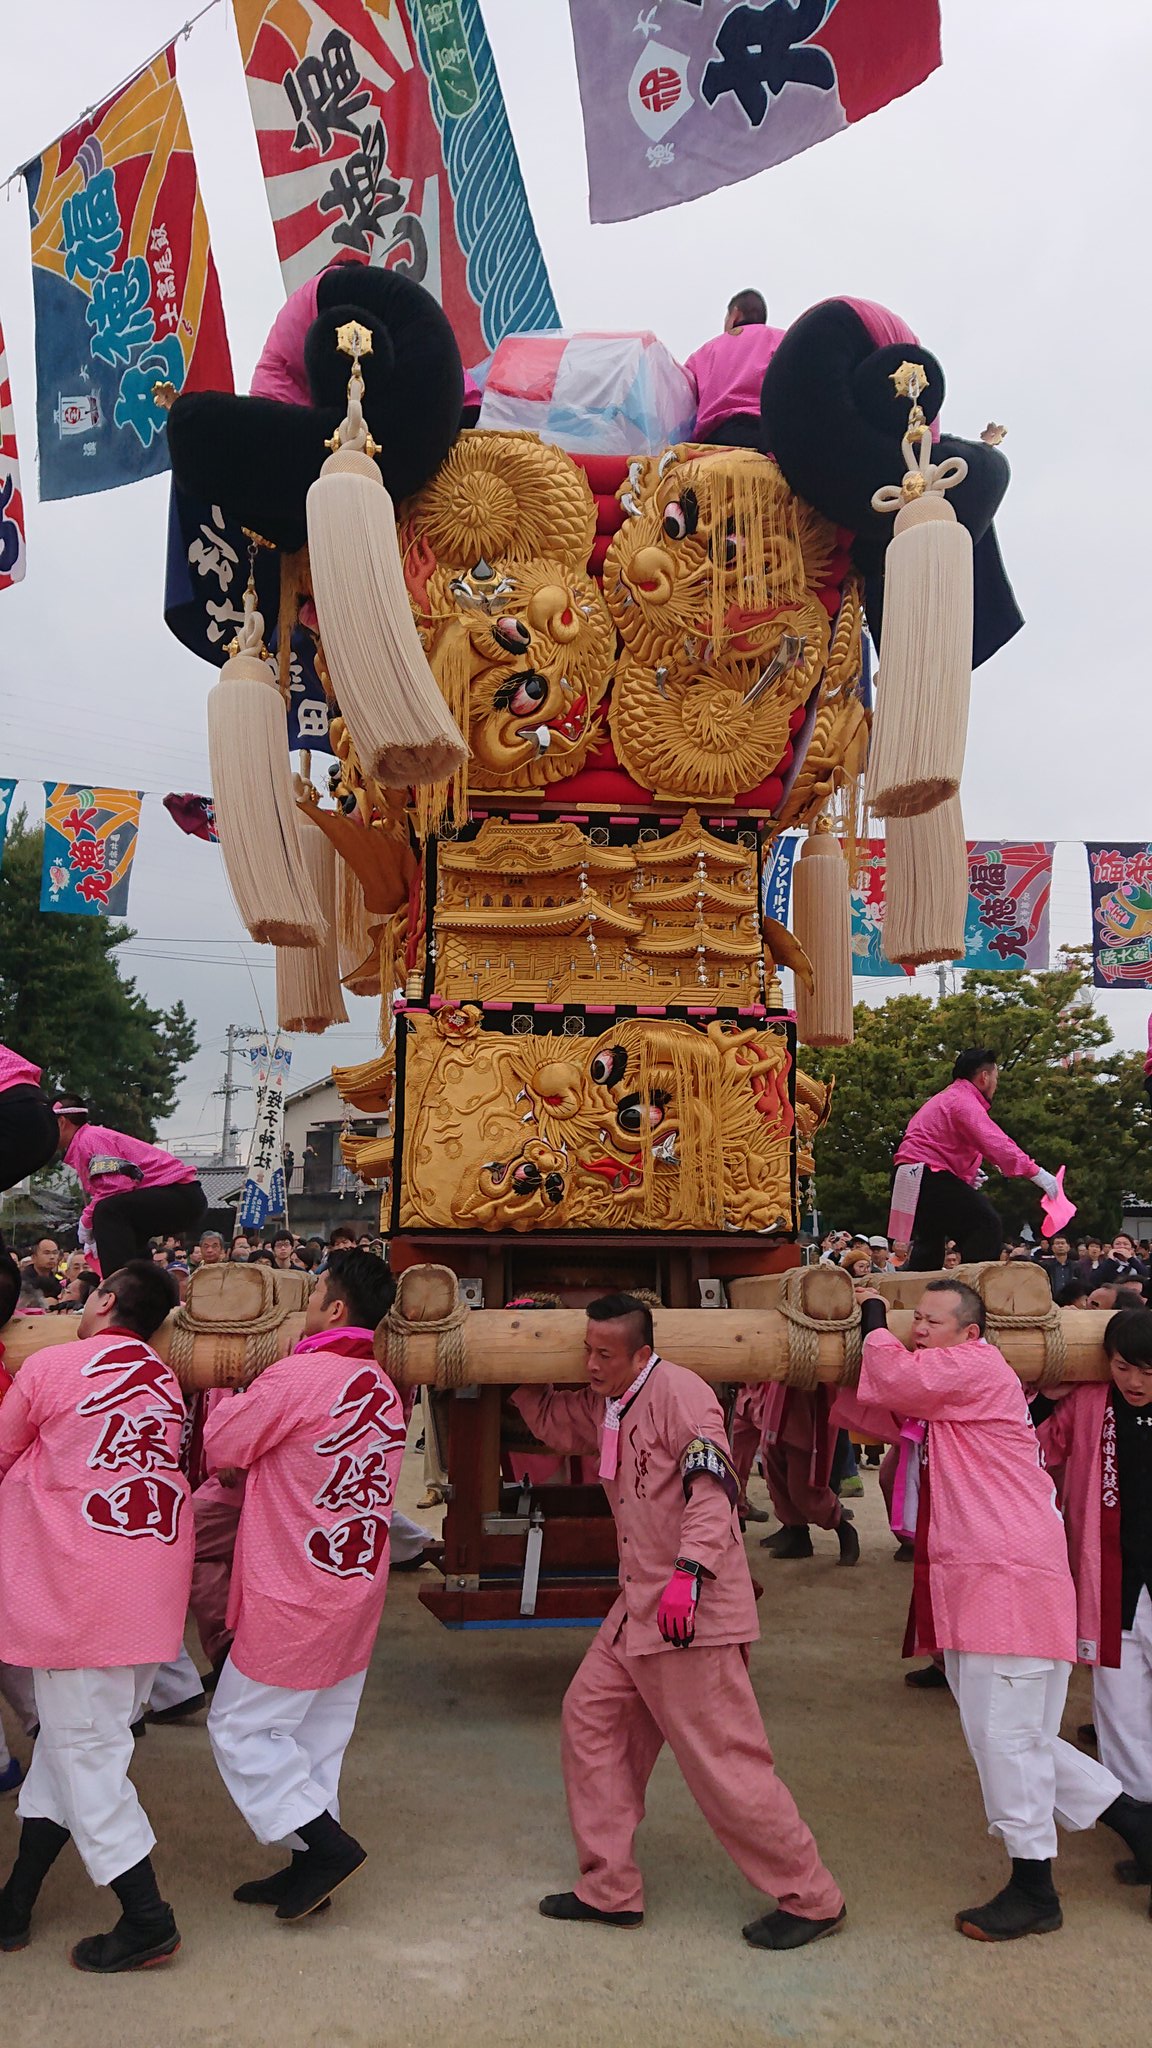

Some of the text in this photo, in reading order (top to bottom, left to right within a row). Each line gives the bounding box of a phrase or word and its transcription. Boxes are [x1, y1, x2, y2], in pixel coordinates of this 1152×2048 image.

[62, 807, 113, 905] 大漁丸
[969, 863, 1028, 961] 福徳丸
[77, 1341, 187, 1544] 久保田
[304, 1366, 406, 1581] 久保田
[1102, 1406, 1119, 1508] 久保田太鼓台
